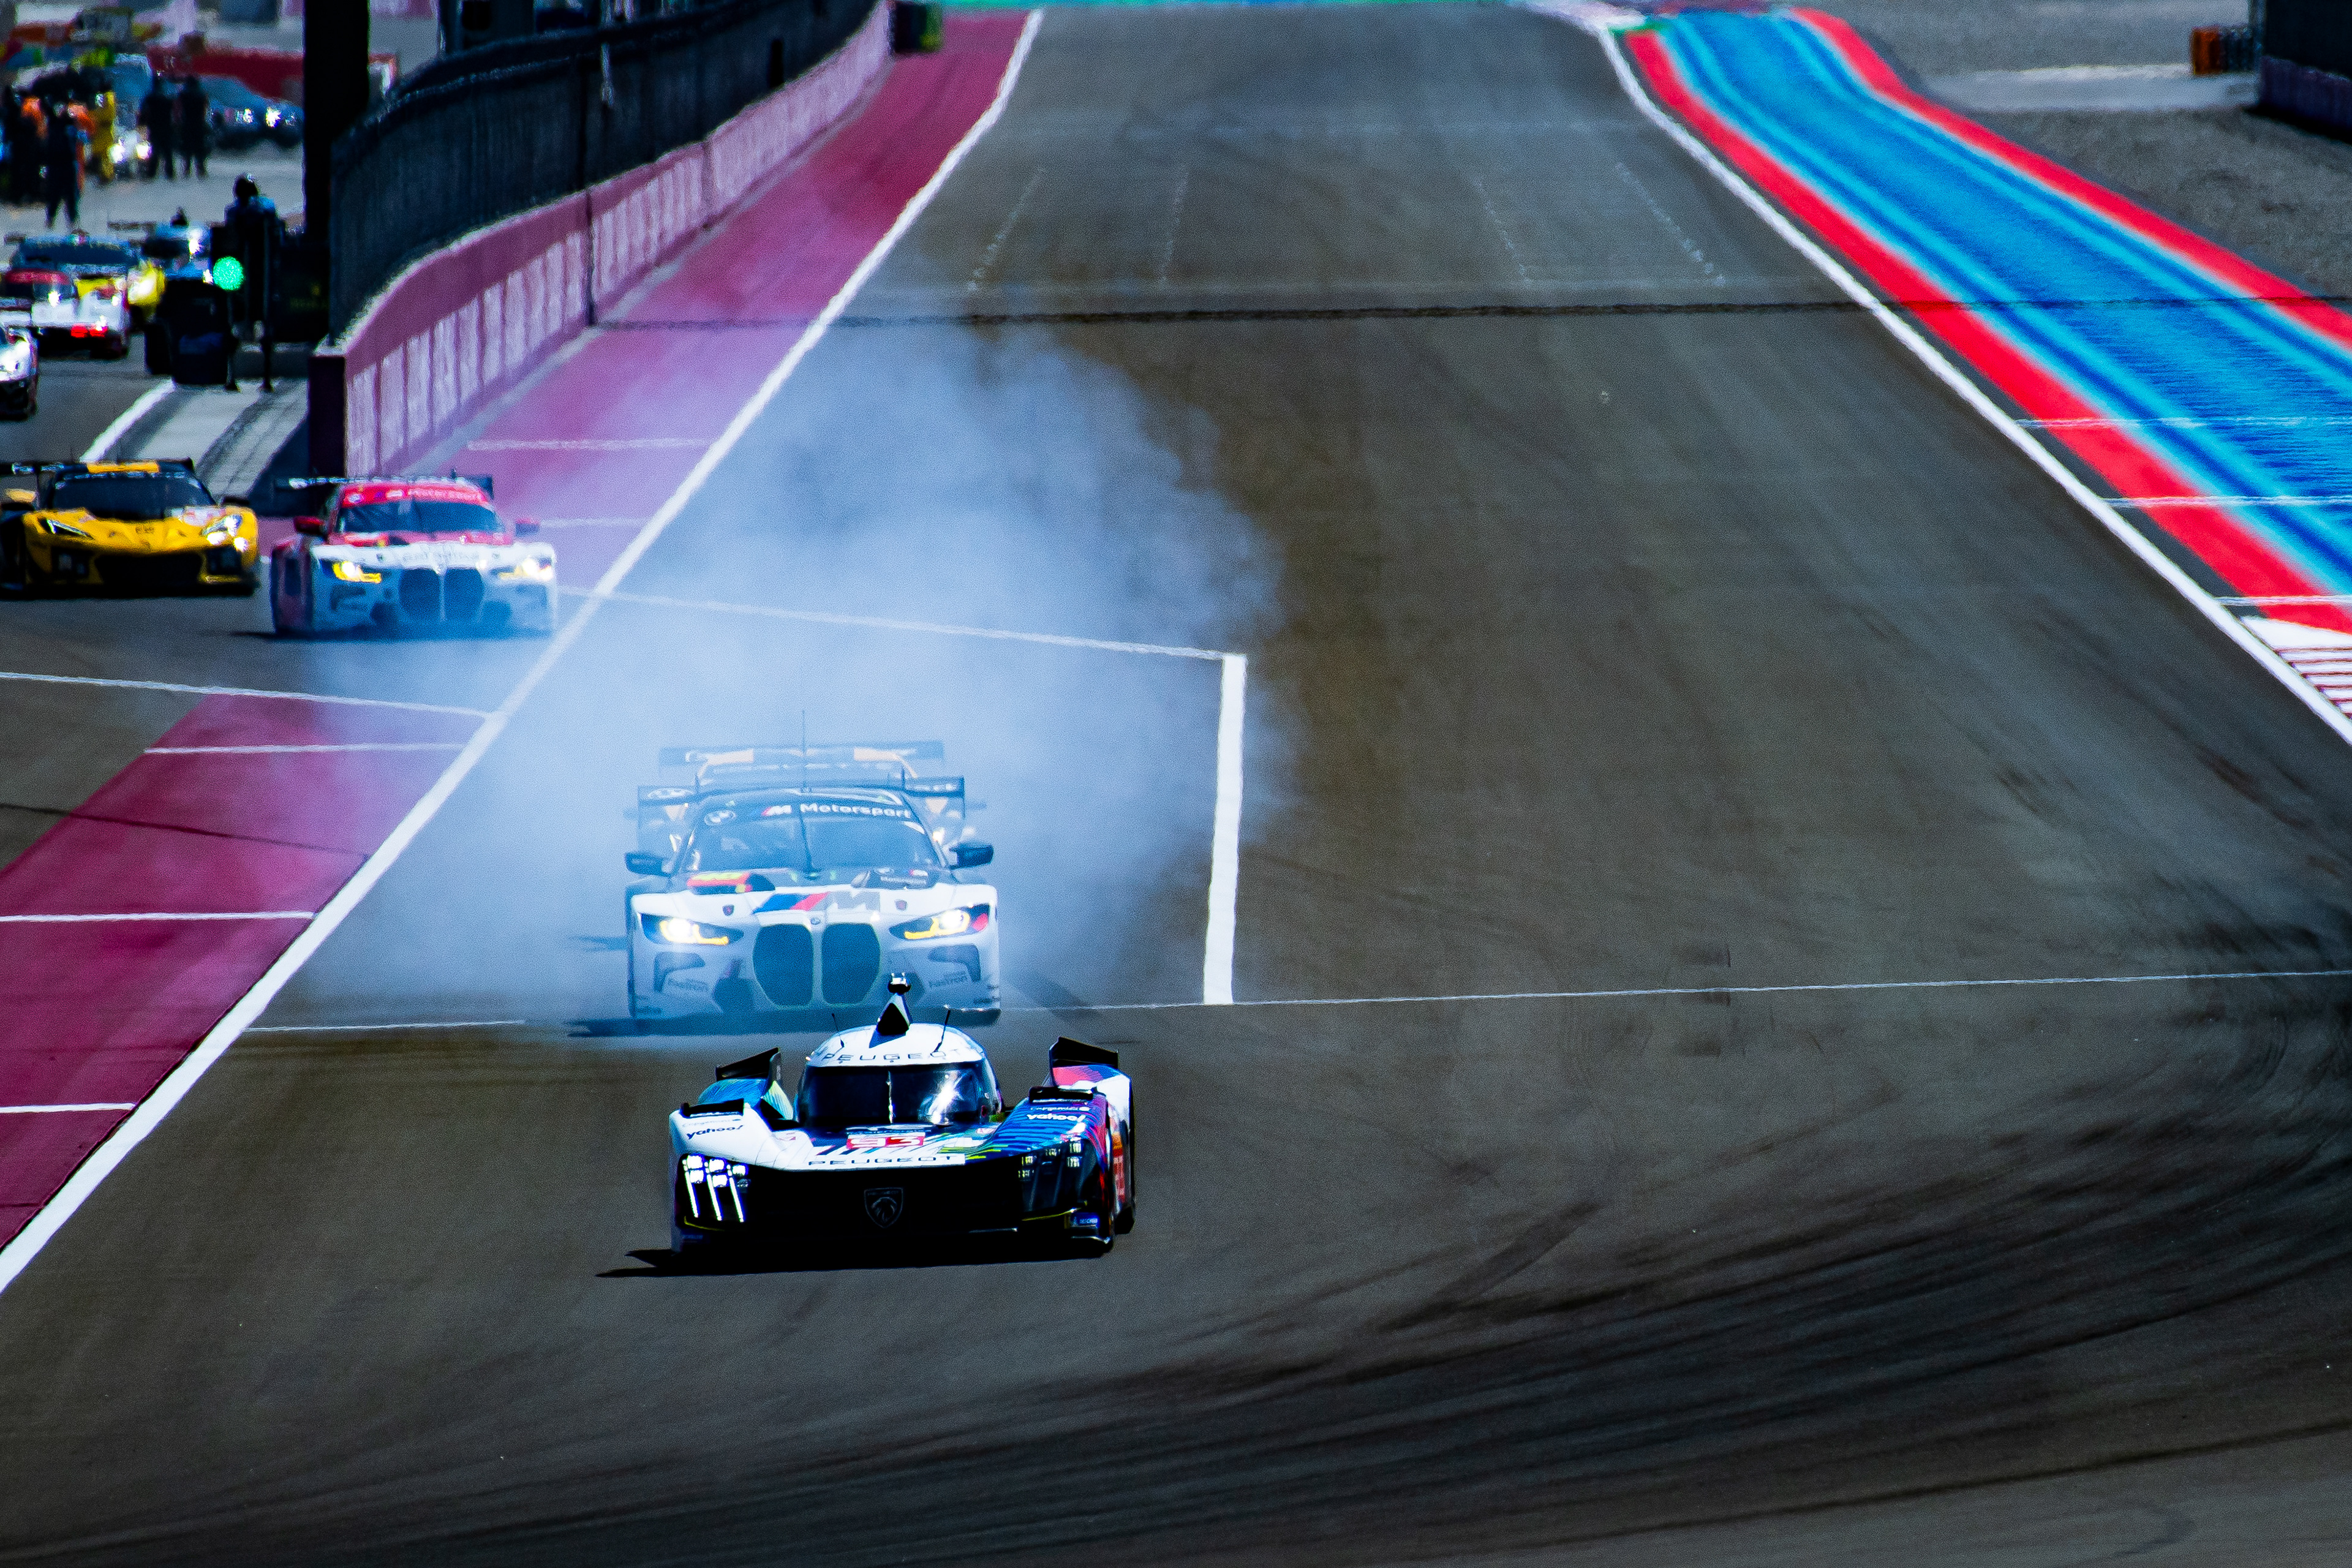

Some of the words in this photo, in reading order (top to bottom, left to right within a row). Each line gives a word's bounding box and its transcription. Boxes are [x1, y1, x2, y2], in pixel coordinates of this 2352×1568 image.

[799, 803, 911, 818] Motorsport
[821, 1048, 959, 1061] PEUGEOT
[1027, 1113, 1087, 1122] yahoo!
[686, 1125, 744, 1140] yahoo!
[849, 1136, 921, 1147] 93
[808, 1156, 951, 1166] PEUGEOT
